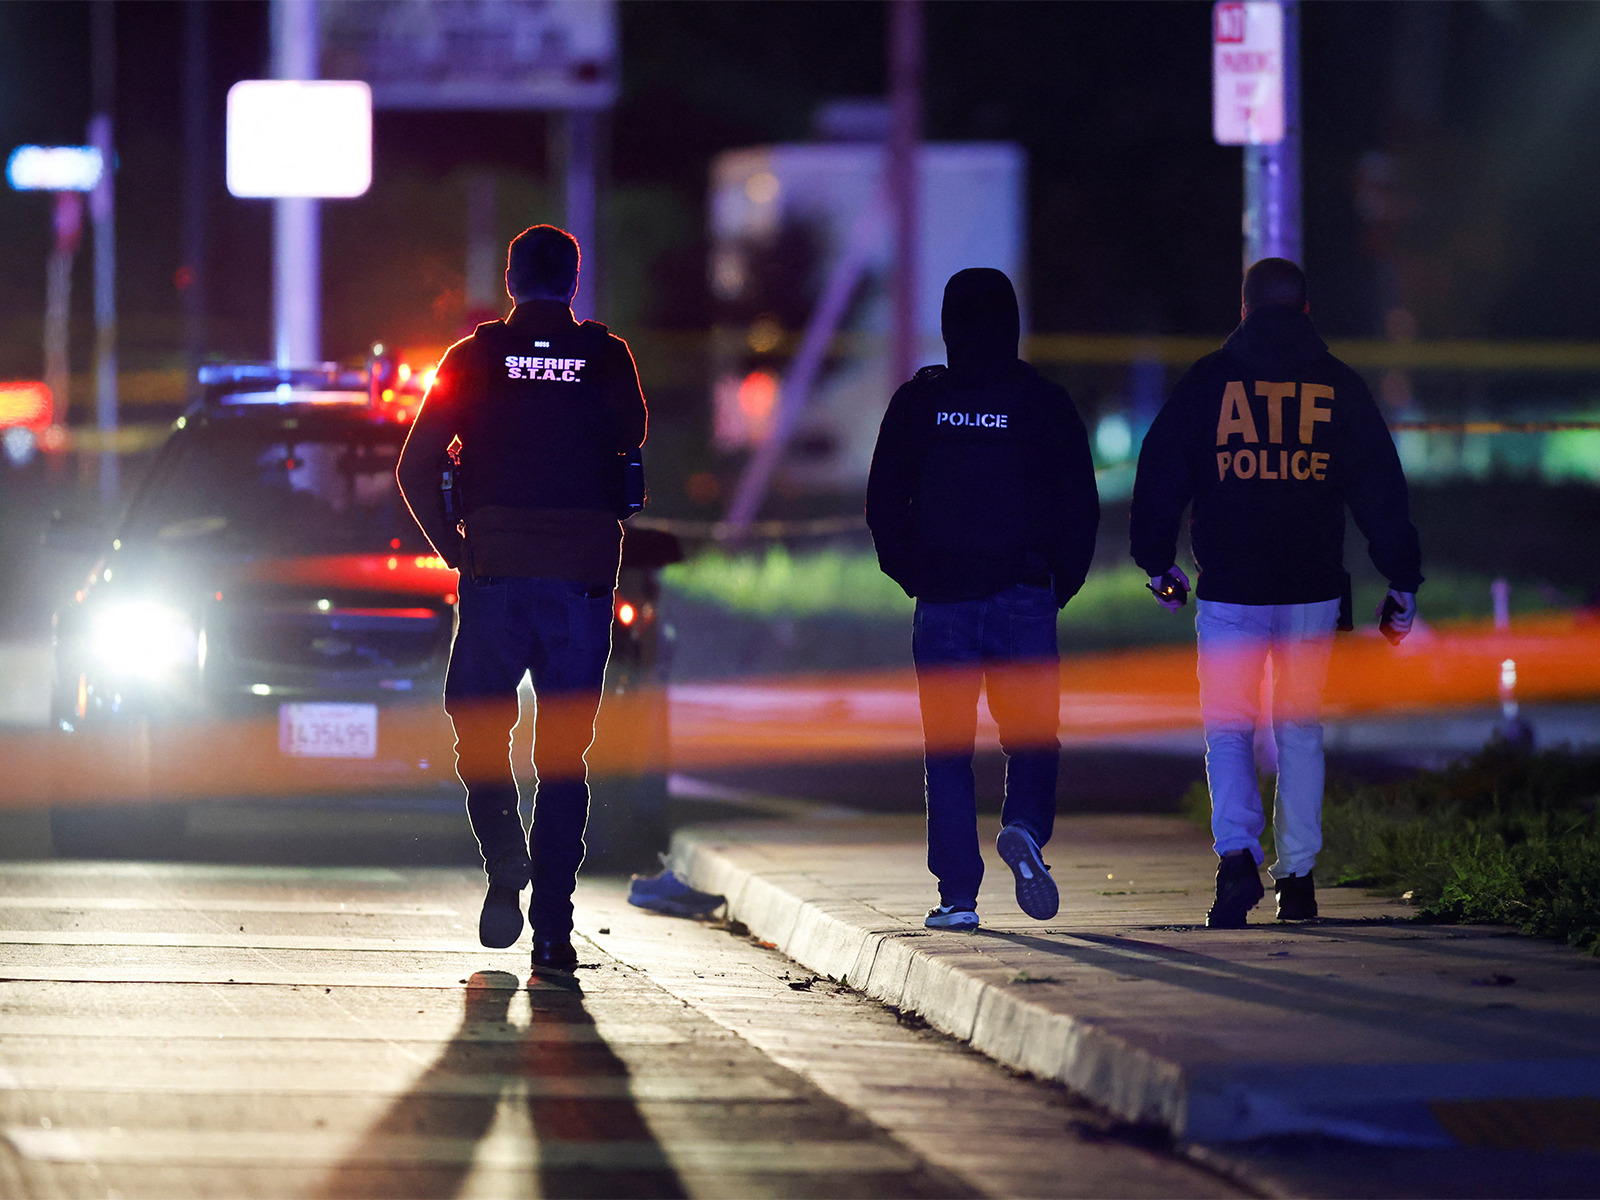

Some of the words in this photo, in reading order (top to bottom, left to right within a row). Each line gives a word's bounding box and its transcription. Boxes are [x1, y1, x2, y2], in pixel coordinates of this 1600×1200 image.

[505, 355, 586, 371] SHERIFF
[507, 367, 581, 382] S.T.A.C.
[936, 412, 1008, 428] POLICE
[1216, 380, 1335, 446] ATF
[1216, 449, 1330, 482] POLICE
